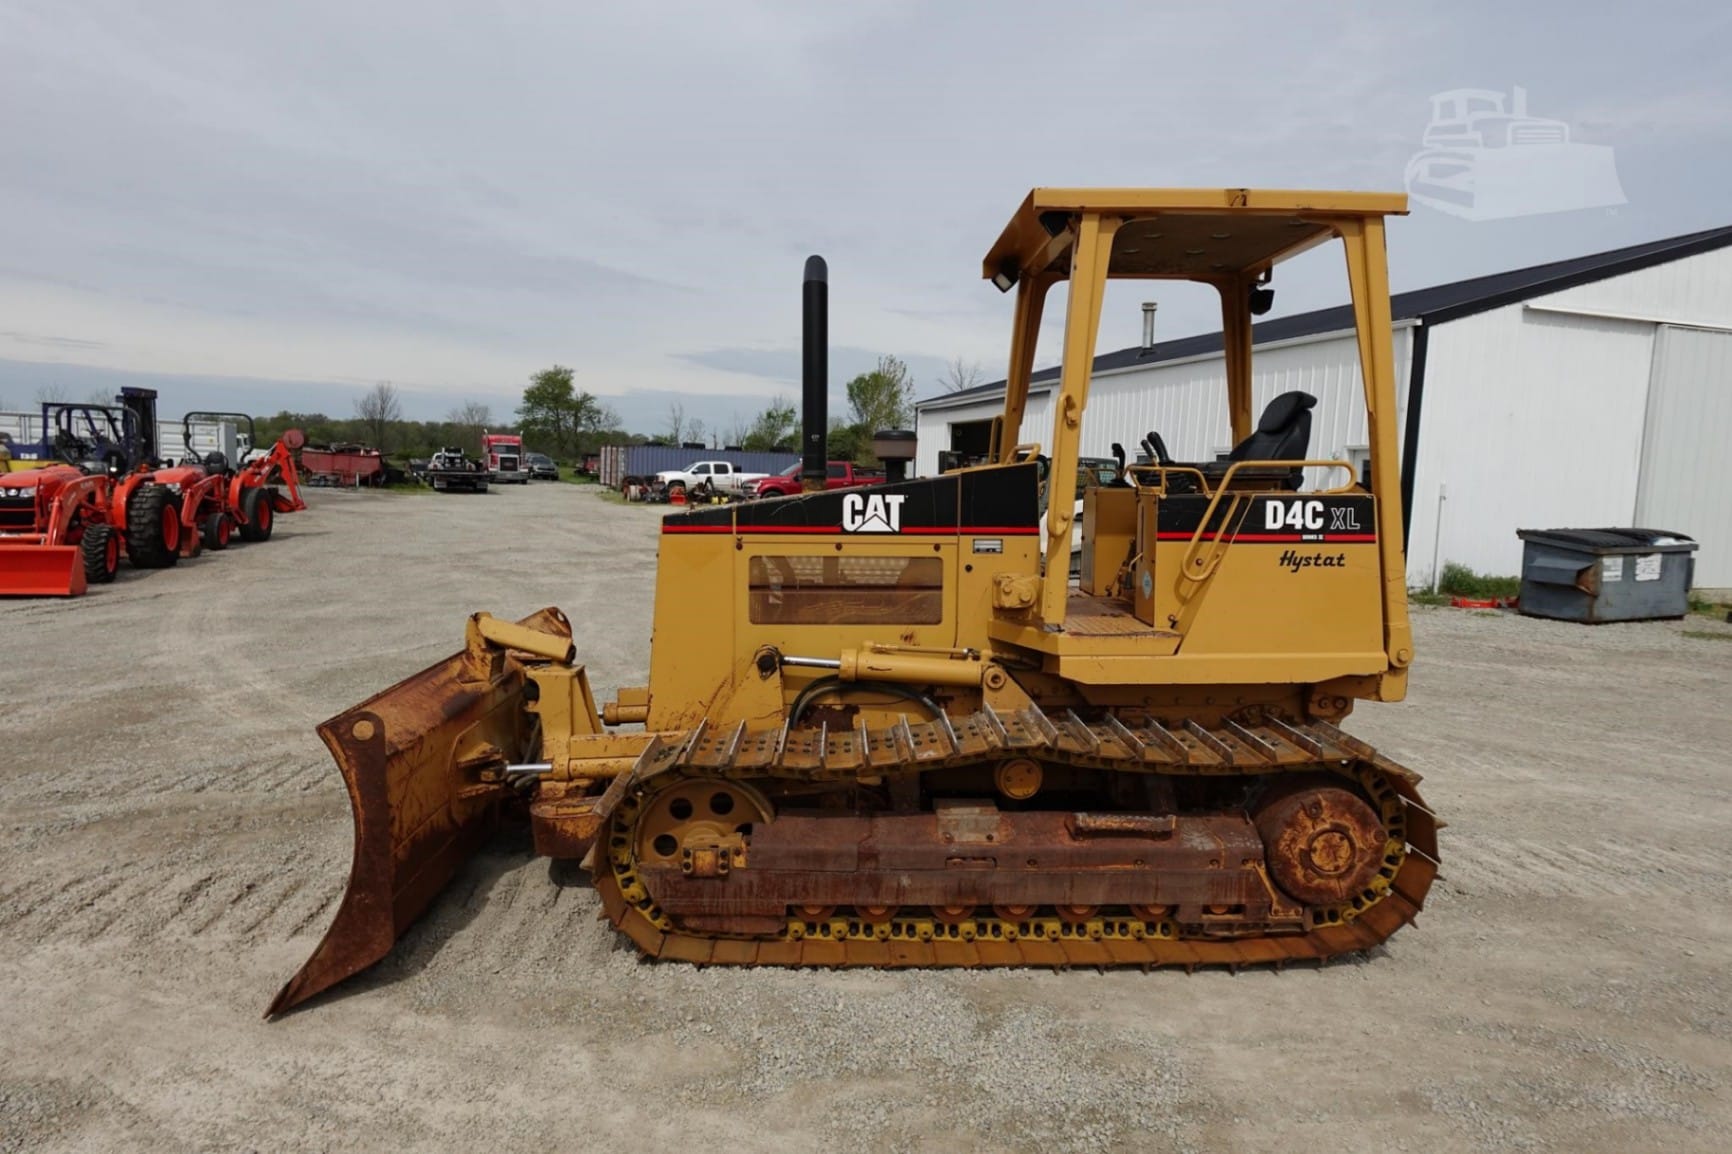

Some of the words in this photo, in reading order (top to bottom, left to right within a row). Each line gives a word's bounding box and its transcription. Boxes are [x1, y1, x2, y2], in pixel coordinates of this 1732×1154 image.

[842, 493, 905, 532] CAT
[1265, 500, 1324, 530] D4C
[1330, 507, 1361, 530] XL
[1279, 550, 1346, 573] Hystat
